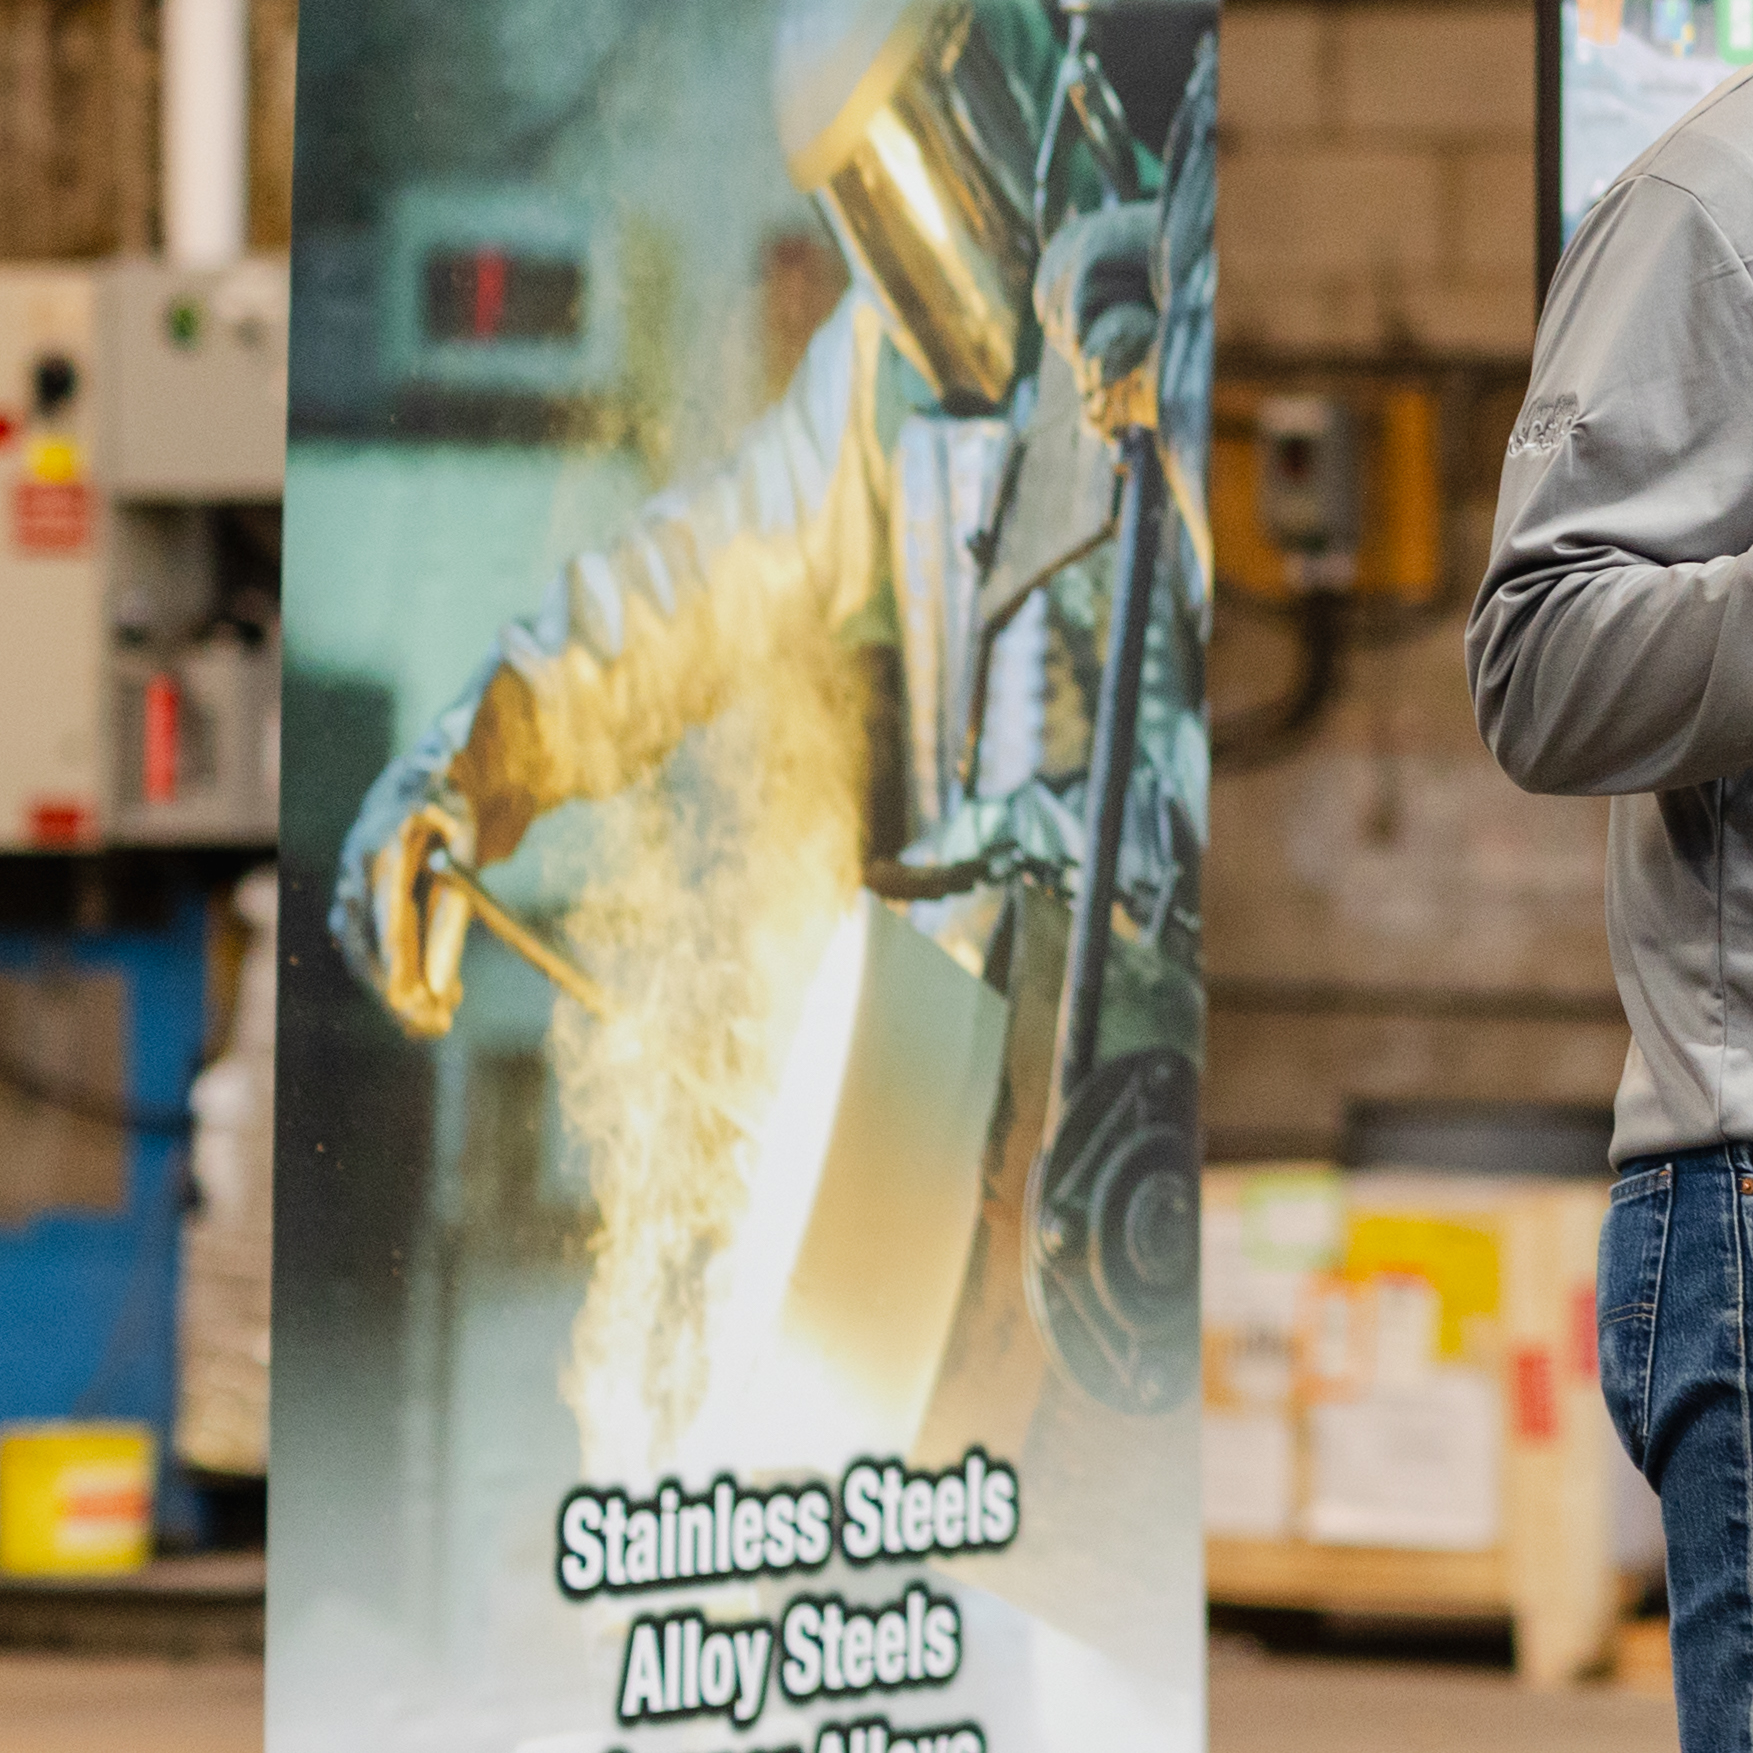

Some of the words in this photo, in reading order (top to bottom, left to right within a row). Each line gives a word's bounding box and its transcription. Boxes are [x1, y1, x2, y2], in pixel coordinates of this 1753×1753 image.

[560, 1486, 831, 1593] Stainless
[843, 1452, 1017, 1559] Steels
[620, 1618, 771, 1723] Alloy
[782, 1591, 959, 1697] Steels
